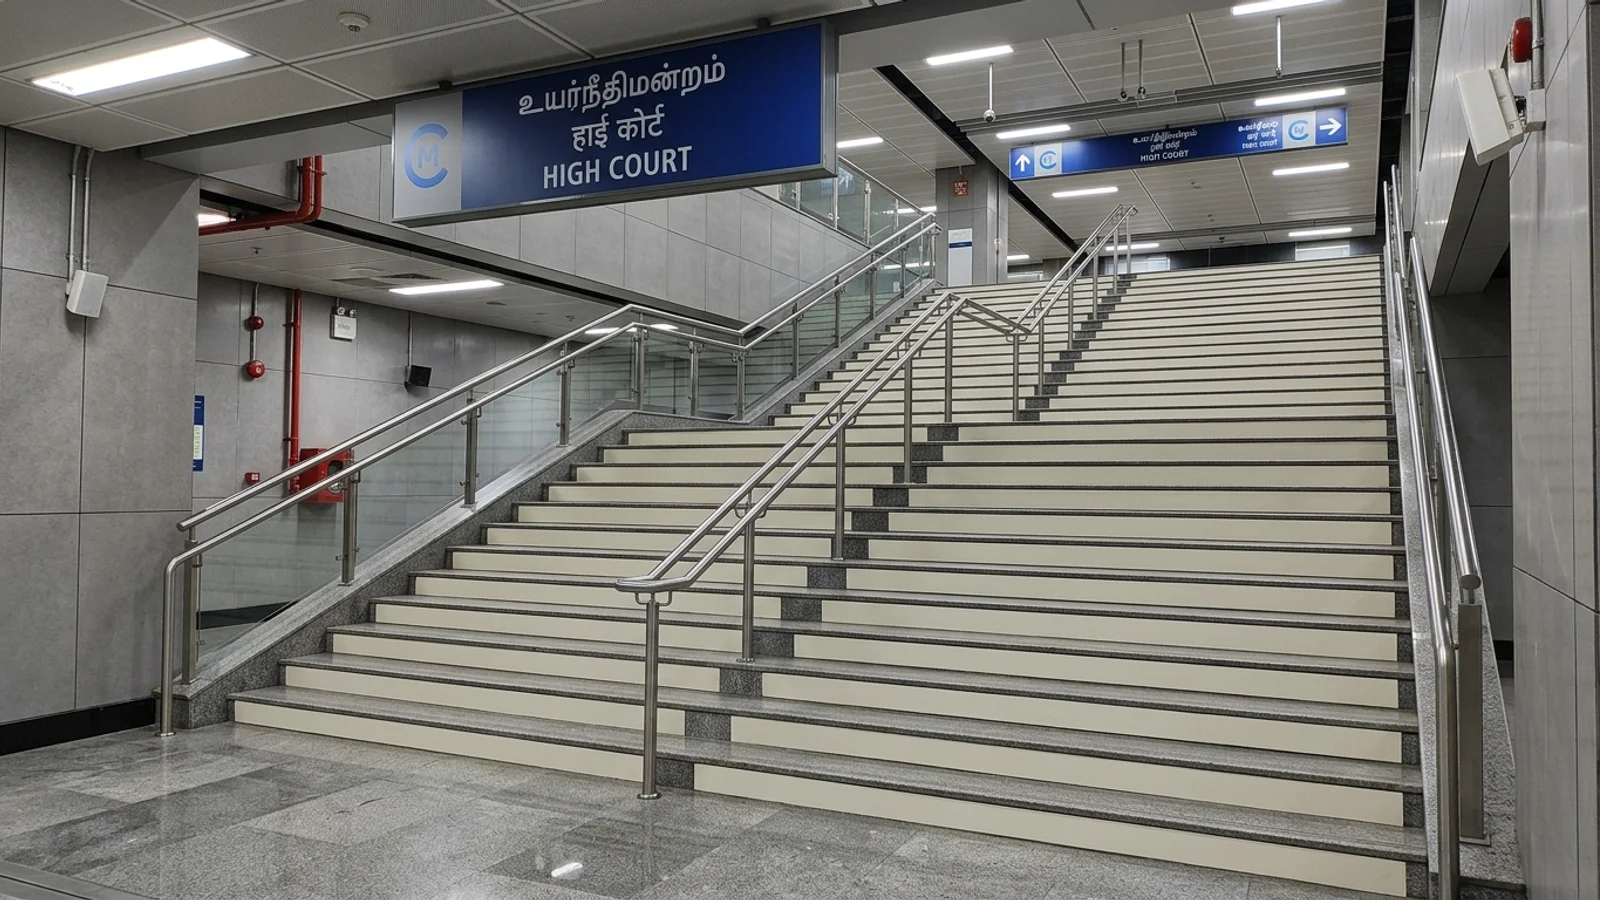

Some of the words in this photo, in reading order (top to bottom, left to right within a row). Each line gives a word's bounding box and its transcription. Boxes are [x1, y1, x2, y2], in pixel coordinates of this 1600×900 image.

[518, 53, 726, 115] உயர்நீதிமன்றம்
[571, 113, 610, 152] हाई
[616, 103, 665, 141] कोर्ट
[543, 158, 600, 189] HIGH
[608, 145, 693, 180] COURT
